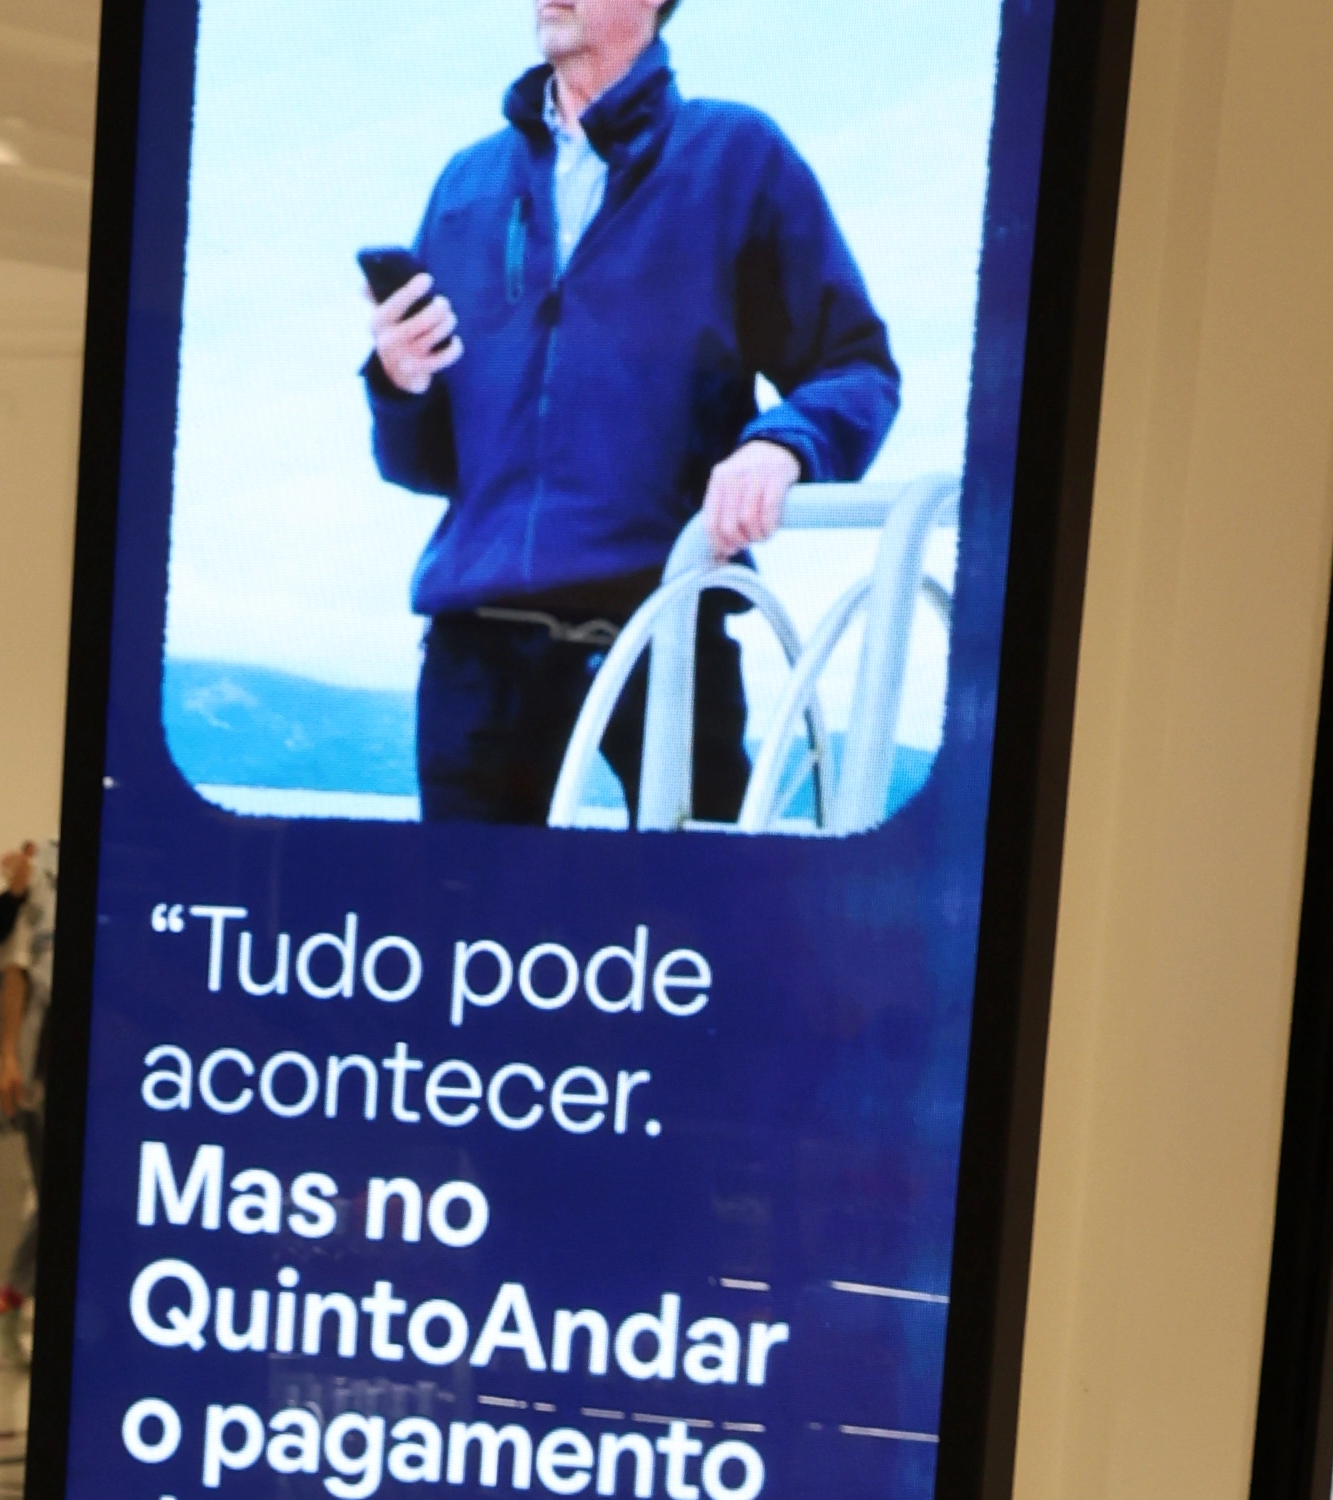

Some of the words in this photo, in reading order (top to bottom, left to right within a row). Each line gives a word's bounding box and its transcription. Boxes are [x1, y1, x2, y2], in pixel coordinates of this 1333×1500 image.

[152, 904, 421, 1002] “Tudo
[452, 925, 711, 1025] pode
[142, 1042, 660, 1135] acontecer.
[138, 1142, 338, 1238] Mas
[366, 1178, 488, 1247] no
[130, 1260, 789, 1386] QuintoAndar
[122, 1399, 181, 1463] o
